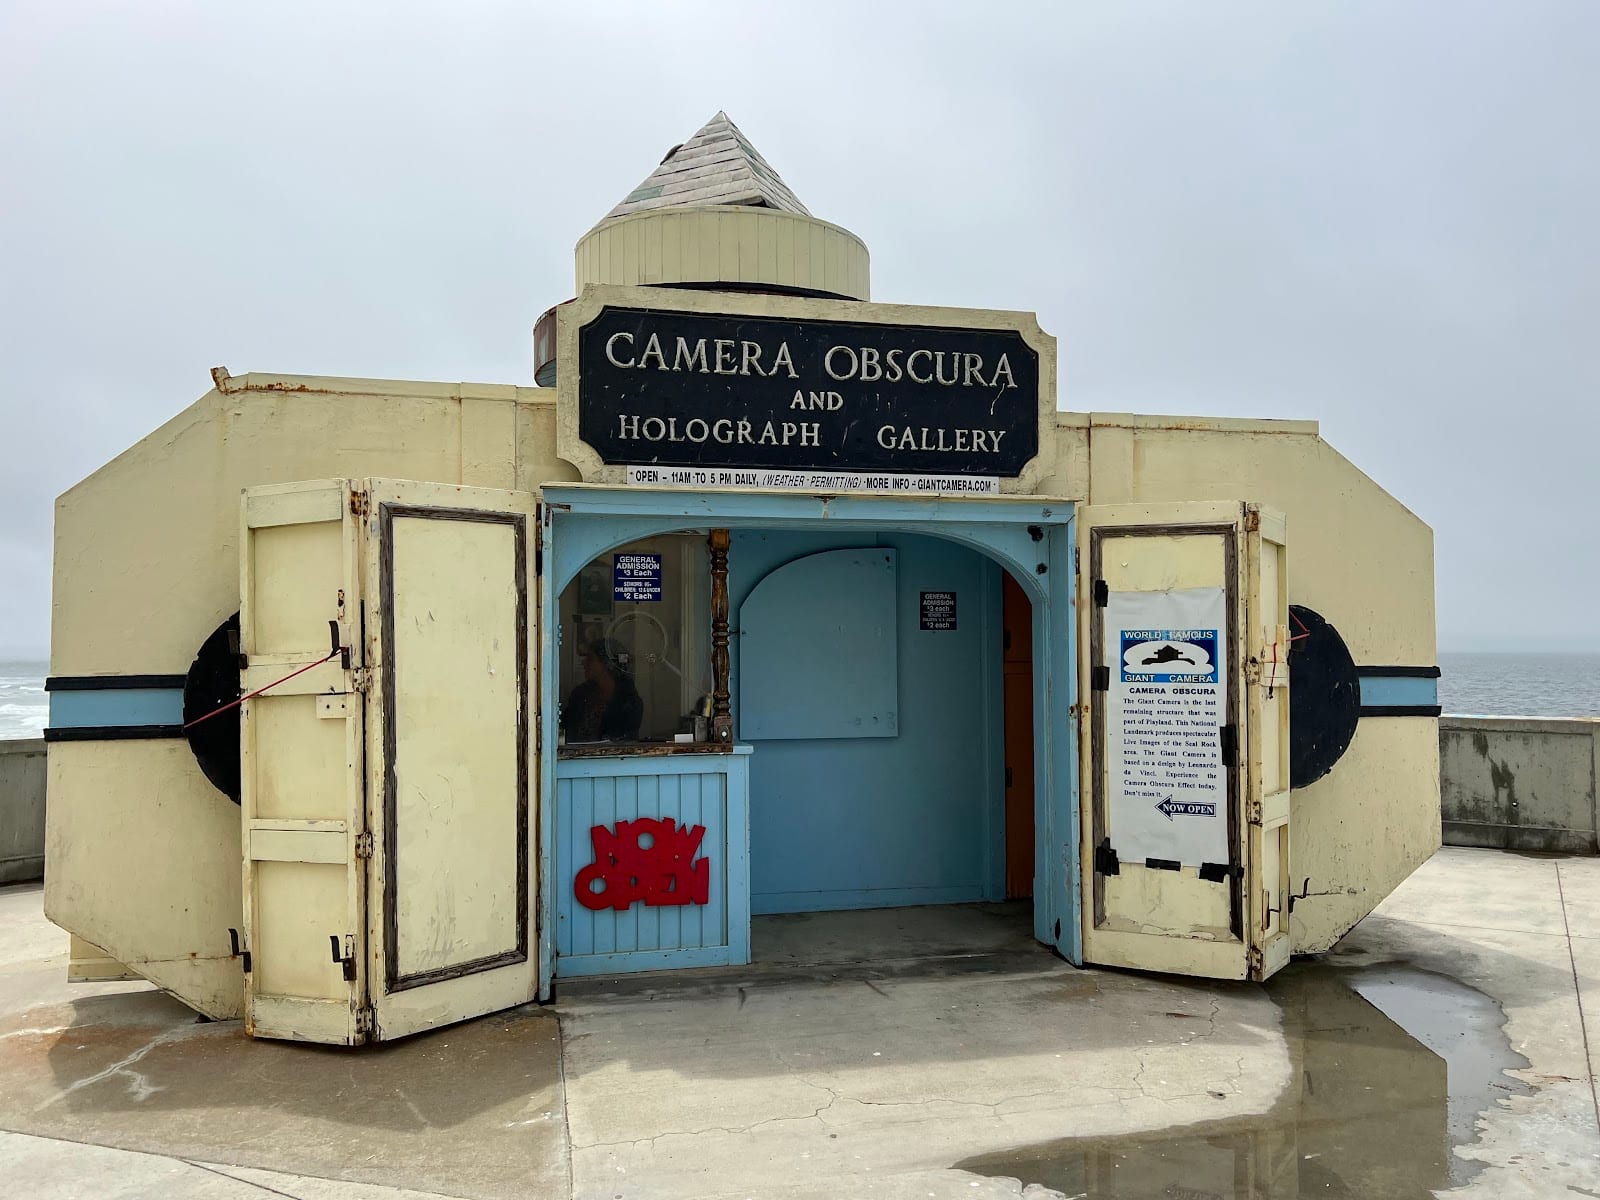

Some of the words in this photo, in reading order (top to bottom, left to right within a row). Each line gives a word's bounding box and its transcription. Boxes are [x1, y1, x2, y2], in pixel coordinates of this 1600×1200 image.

[605, 332, 799, 378] CAMERA
[824, 345, 1018, 388] OBSCURA
[790, 389, 844, 411] AND
[618, 414, 820, 447] HOLOGRAPH
[877, 424, 1006, 452] GALLERY
[635, 471, 658, 482] OPEN
[671, 472, 691, 483] 11AM
[695, 472, 706, 484] TO
[710, 473, 716, 484] 5
[719, 473, 732, 485] PM
[735, 474, 759, 487] DAILY,
[762, 474, 804, 487] (WEATHER
[810, 475, 862, 488] PERMITTING)
[866, 477, 889, 489] MORE
[892, 478, 910, 489] INFO
[917, 480, 991, 492] GIANTCAMERA.COM
[1124, 631, 1162, 639] WORLD
[1169, 631, 1214, 639] FAMOUS
[1124, 674, 1156, 682] GIANT
[1169, 674, 1214, 682] CAMERA
[1123, 708, 1153, 716] remaining
[1123, 719, 1136, 727] part
[1146, 719, 1173, 727] Playland.
[1123, 728, 1154, 736] Landmark
[1183, 730, 1217, 738] spectacular
[1139, 739, 1161, 747] Images
[1182, 750, 1206, 758] Camera
[1157, 760, 1176, 768] design
[1178, 761, 1186, 769] by
[1188, 761, 1217, 769] Leonardo
[1166, 771, 1199, 779] Experience
[1149, 780, 1175, 788] Obscura
[1177, 781, 1196, 789] Effect
[1162, 803, 1186, 813] NOW
[1187, 805, 1214, 815] OPEN
[590, 817, 707, 866] NOW
[573, 856, 710, 911] OPEN
